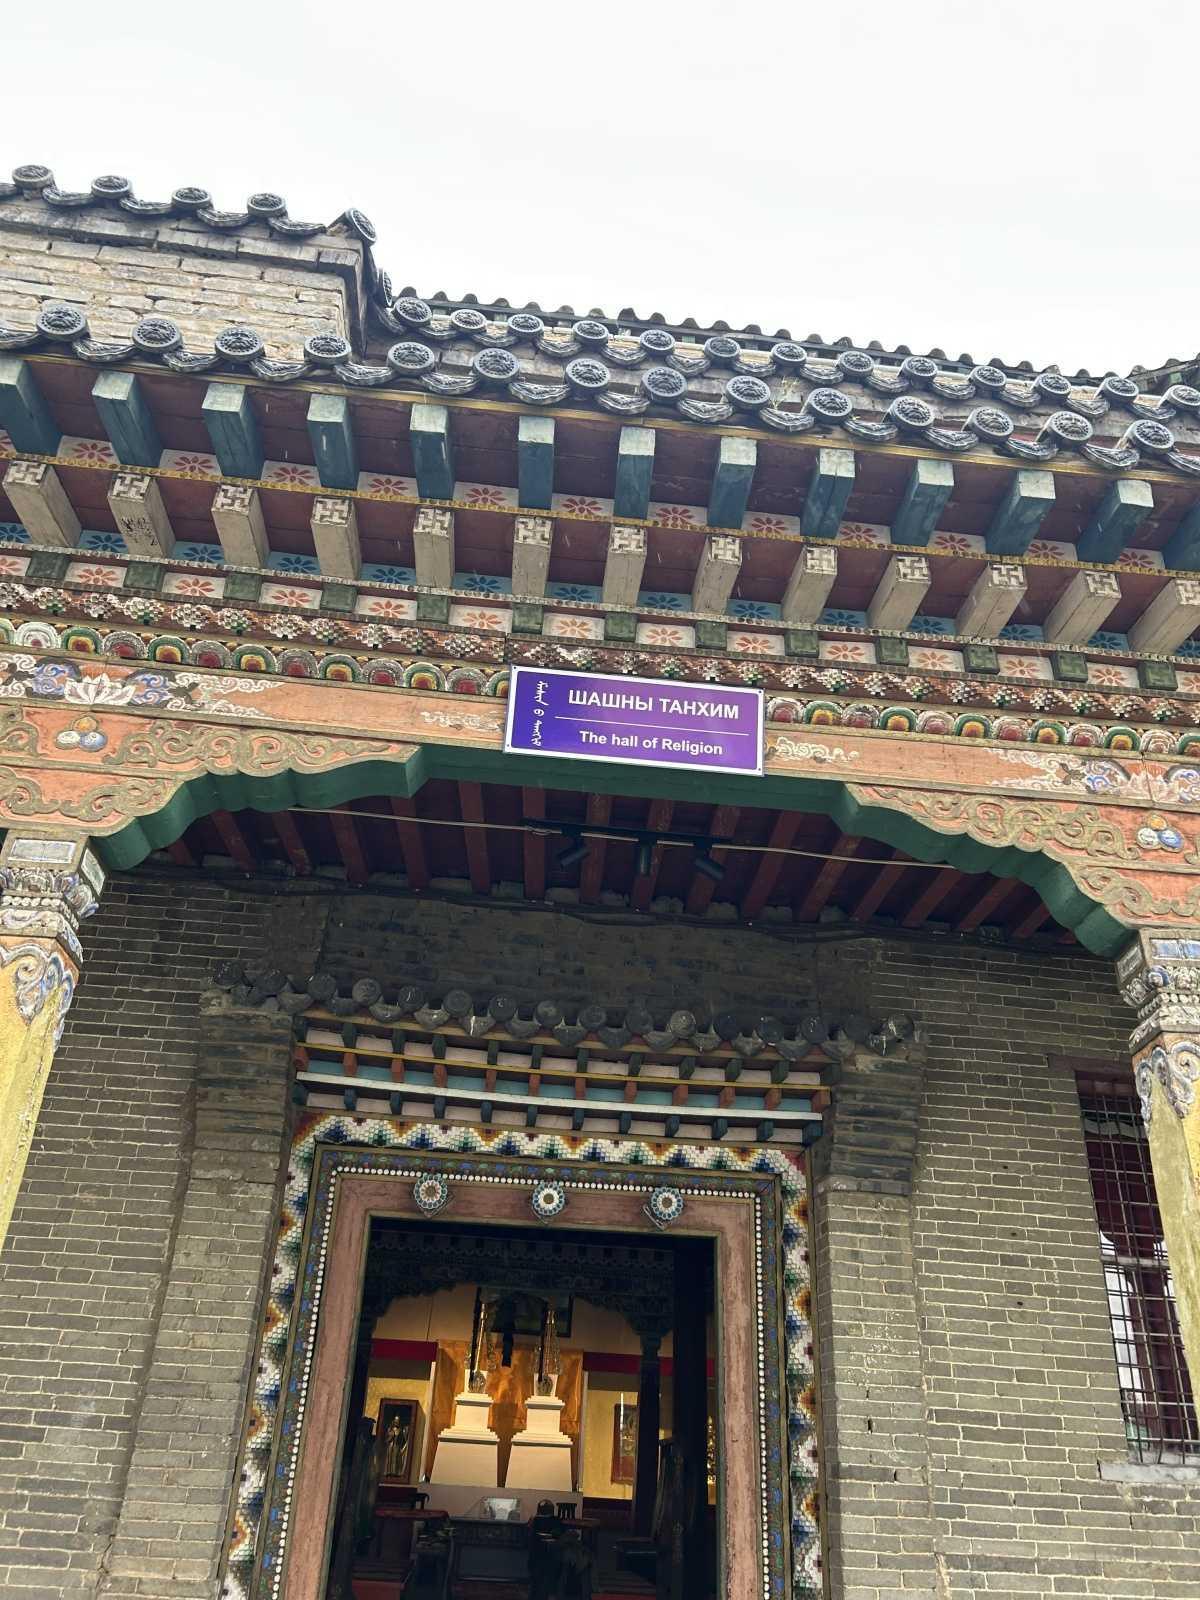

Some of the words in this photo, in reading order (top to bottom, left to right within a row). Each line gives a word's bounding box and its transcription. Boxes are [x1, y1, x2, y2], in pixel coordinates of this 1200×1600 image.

[568, 689, 653, 712] ШАШНЫ
[659, 698, 739, 719] ТАНХИМ
[579, 730, 607, 745] The
[612, 733, 637, 748] hall
[642, 737, 659, 750] of
[662, 738, 723, 756] Religion
